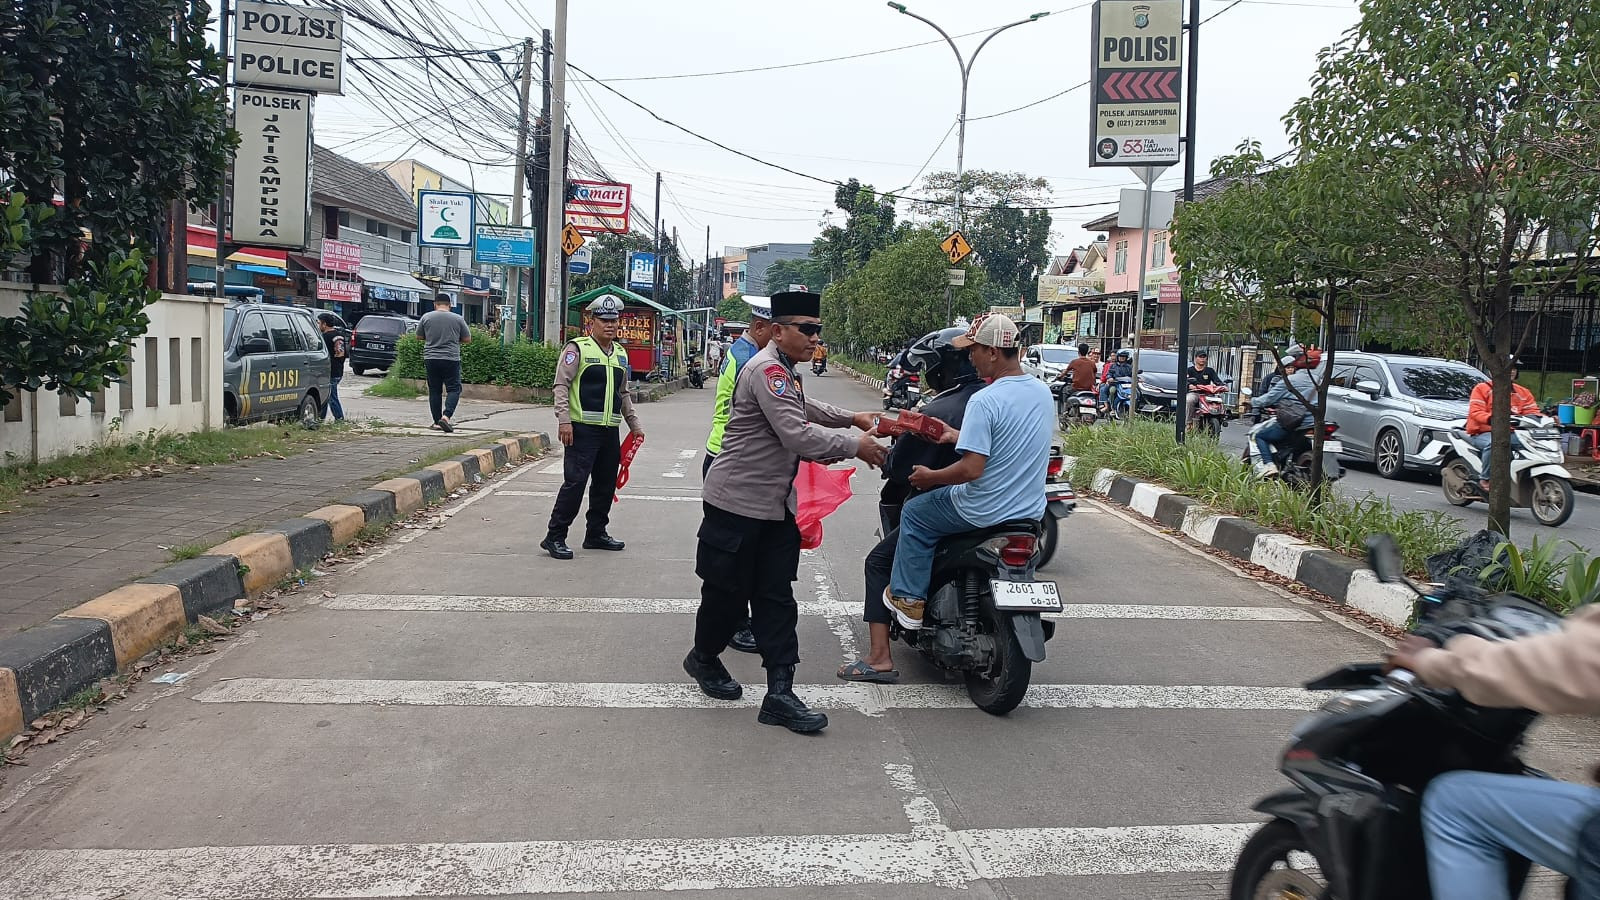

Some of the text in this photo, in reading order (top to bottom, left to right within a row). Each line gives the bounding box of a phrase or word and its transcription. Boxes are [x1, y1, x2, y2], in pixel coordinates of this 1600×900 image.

[242, 10, 337, 40] POLISI
[1104, 36, 1177, 62] POLISI
[240, 53, 335, 80] POLICE
[242, 94, 301, 111] POLSEK
[1117, 120, 1134, 128] (021)
[1122, 139, 1143, 154] 53
[259, 114, 281, 238] JATISAMPURNA
[616, 329, 651, 340] ORENG
[259, 370, 298, 391] POLISI
